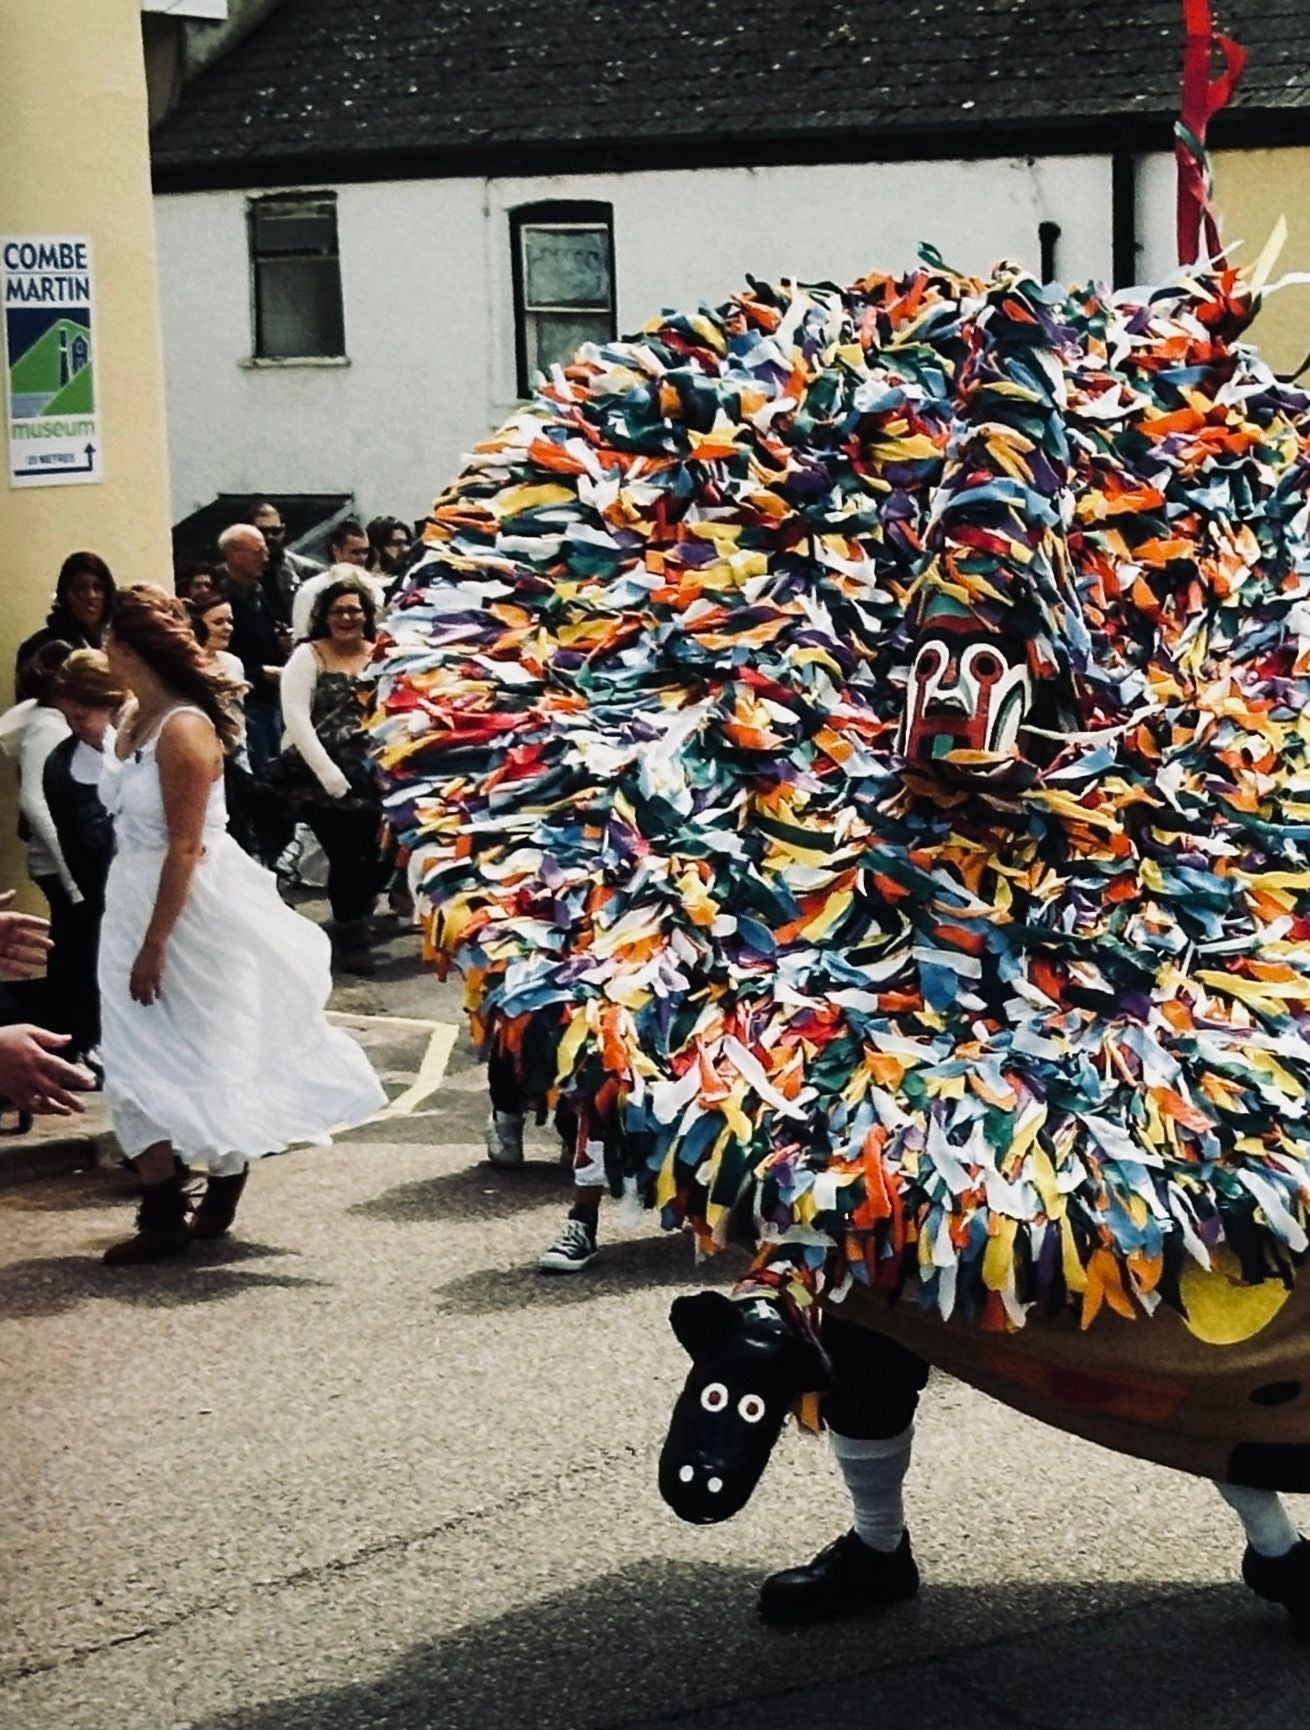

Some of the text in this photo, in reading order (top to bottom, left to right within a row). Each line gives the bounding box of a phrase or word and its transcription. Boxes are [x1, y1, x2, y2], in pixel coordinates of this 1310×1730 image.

[4, 243, 88, 269] COMBE
[6, 276, 90, 302] MARTIN
[12, 421, 95, 440] museum
